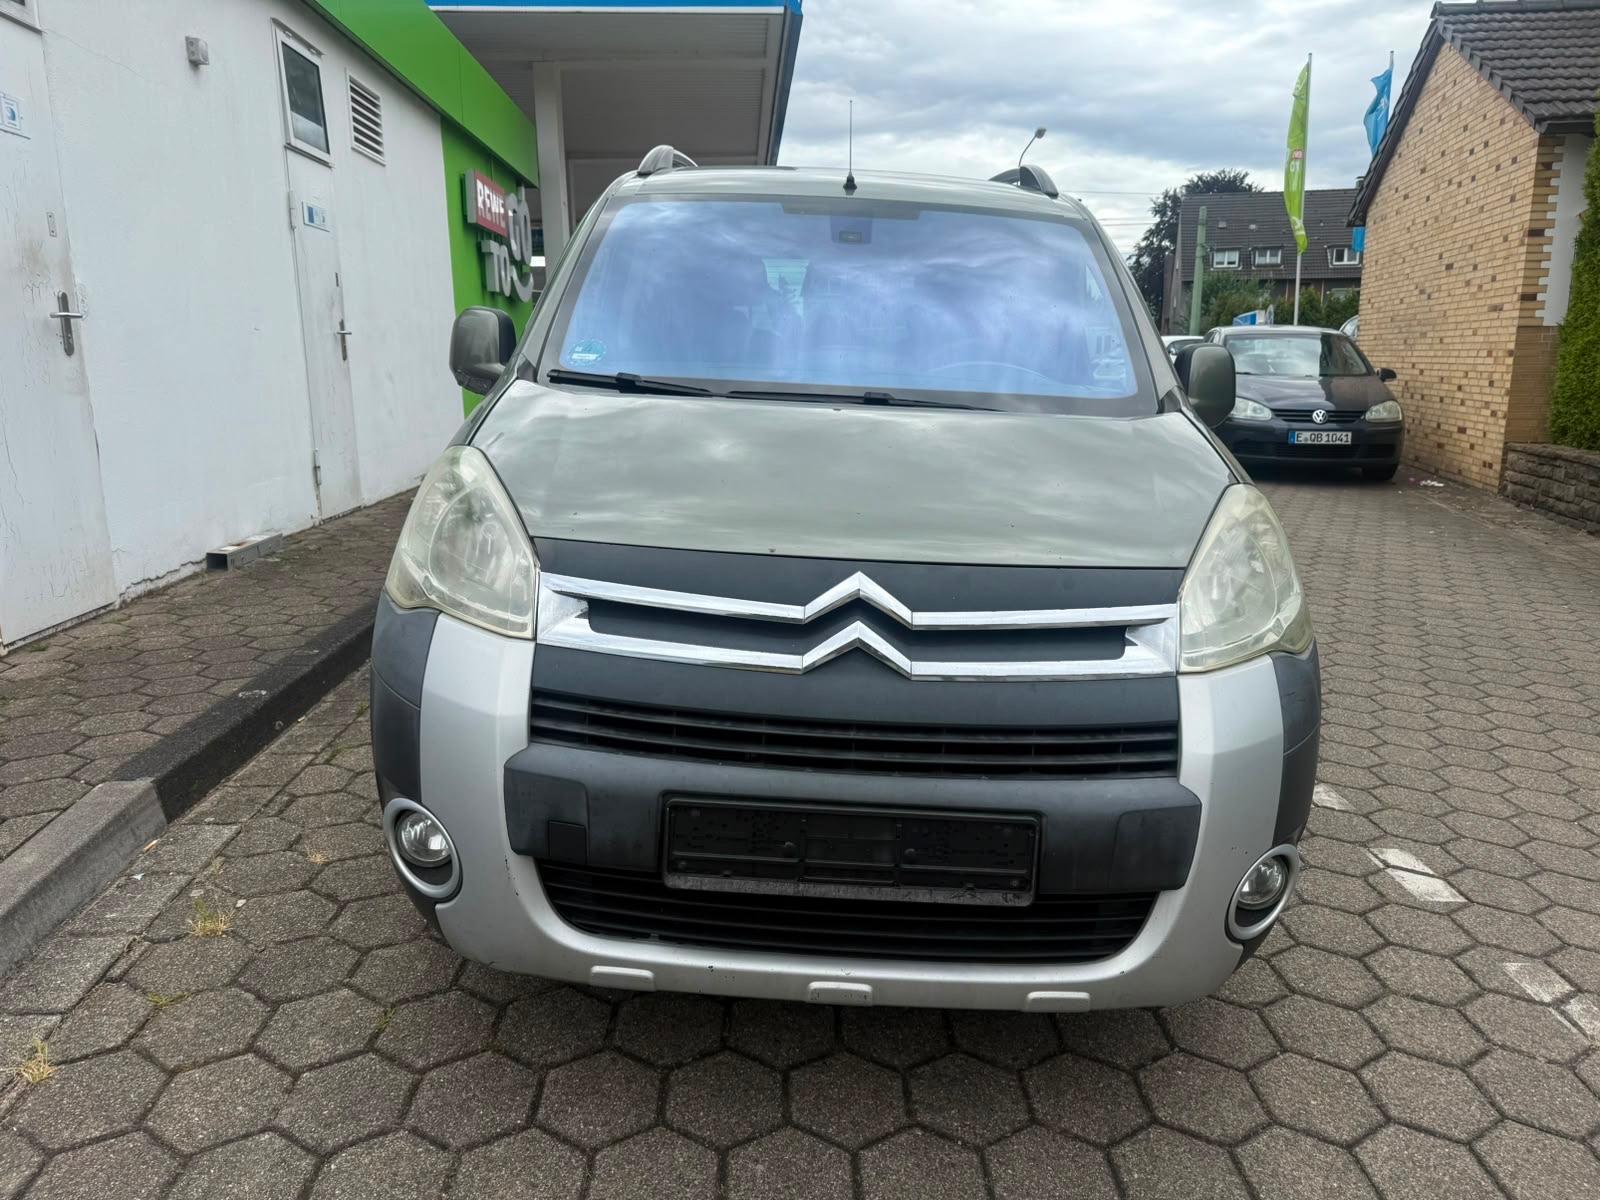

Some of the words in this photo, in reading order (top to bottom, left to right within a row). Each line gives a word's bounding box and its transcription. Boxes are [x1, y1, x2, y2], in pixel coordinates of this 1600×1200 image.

[476, 178, 506, 217] REWE
[482, 239, 512, 297] TO
[1324, 432, 1349, 443] 1041
